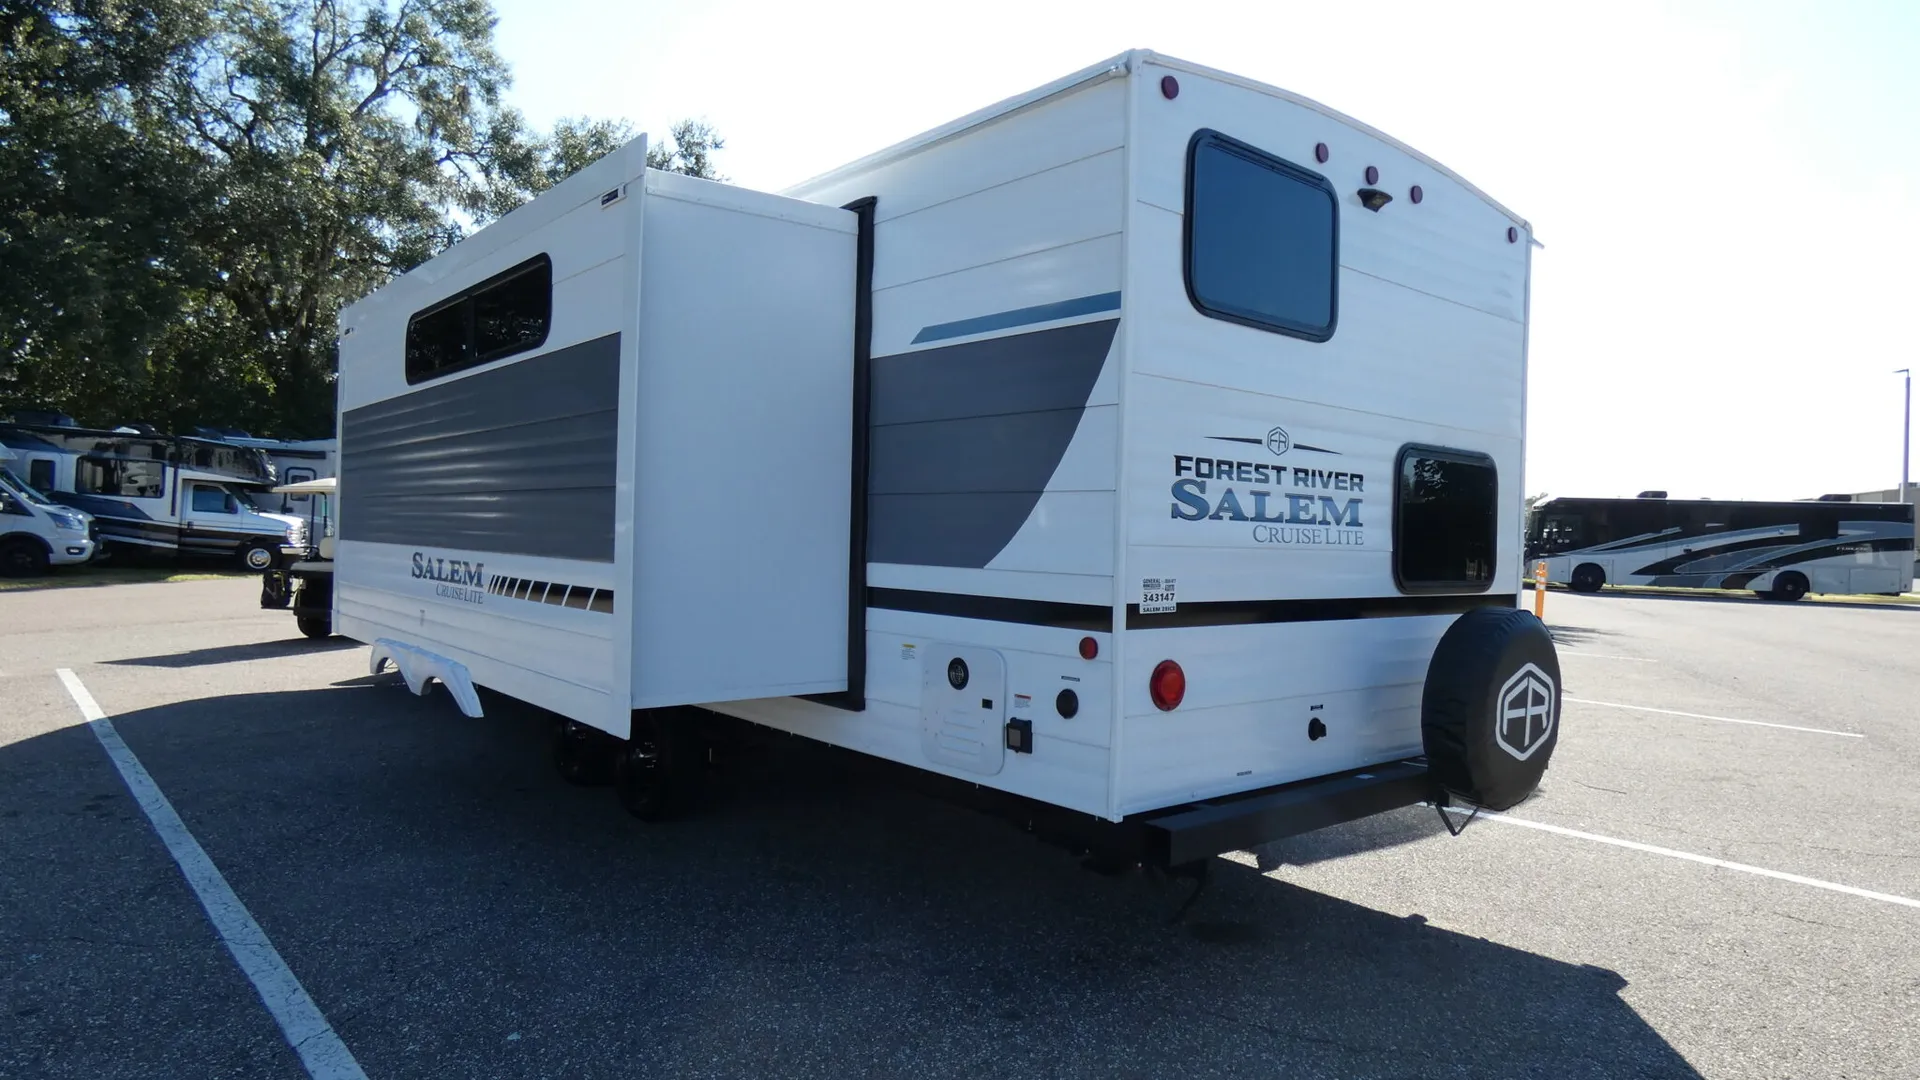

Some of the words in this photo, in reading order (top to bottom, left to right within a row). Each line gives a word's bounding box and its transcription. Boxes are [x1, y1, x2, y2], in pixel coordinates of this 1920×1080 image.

[1173, 454, 1287, 485] FOREST
[1292, 467, 1364, 492] RIVER
[1171, 479, 1363, 527] SALEM
[411, 551, 485, 588] SALEM
[1143, 593, 1175, 602] 343147
